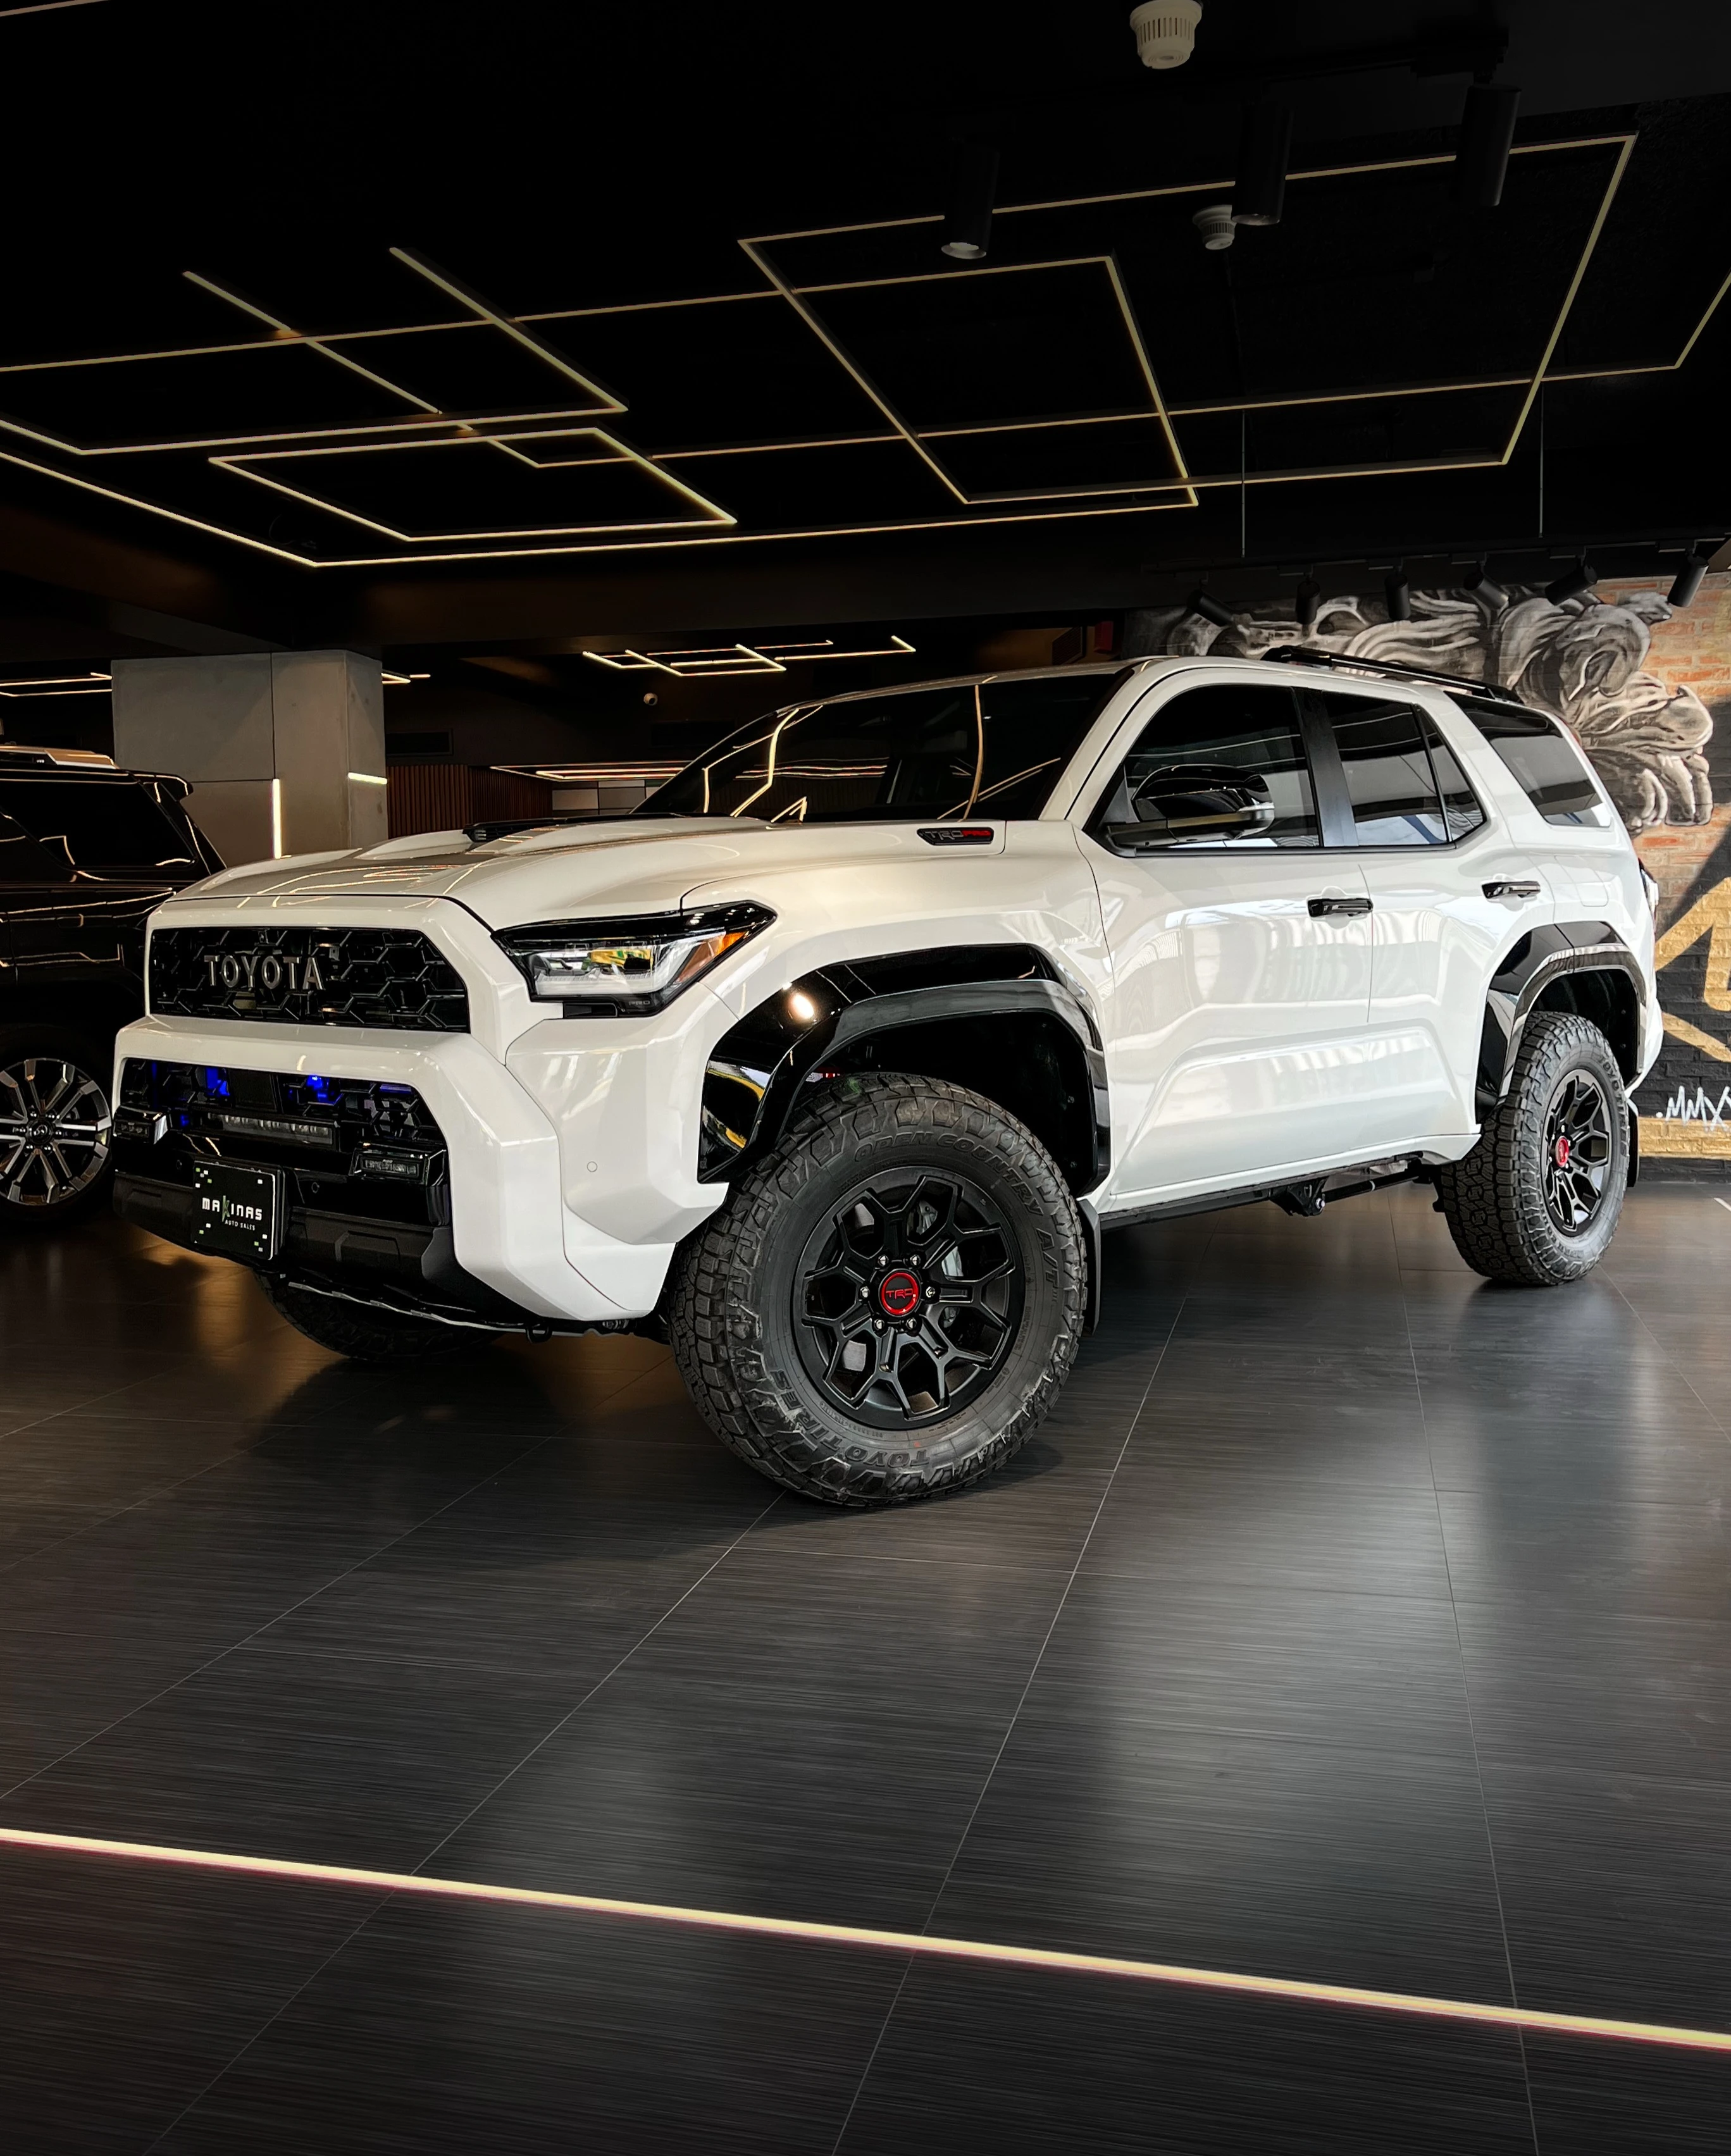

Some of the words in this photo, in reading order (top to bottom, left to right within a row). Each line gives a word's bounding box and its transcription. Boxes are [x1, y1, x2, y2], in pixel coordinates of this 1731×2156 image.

[924, 830, 964, 840] TRD
[203, 955, 326, 990] TOYOTA
[854, 1131, 934, 1162] OPEN
[936, 1134, 1045, 1217] COUNTRY
[225, 1219, 239, 1227] AUTO
[240, 1222, 256, 1231] SALES
[886, 1288, 914, 1299] TRD
[769, 1369, 843, 1451] TIRES
[845, 1446, 931, 1468] TOYO
